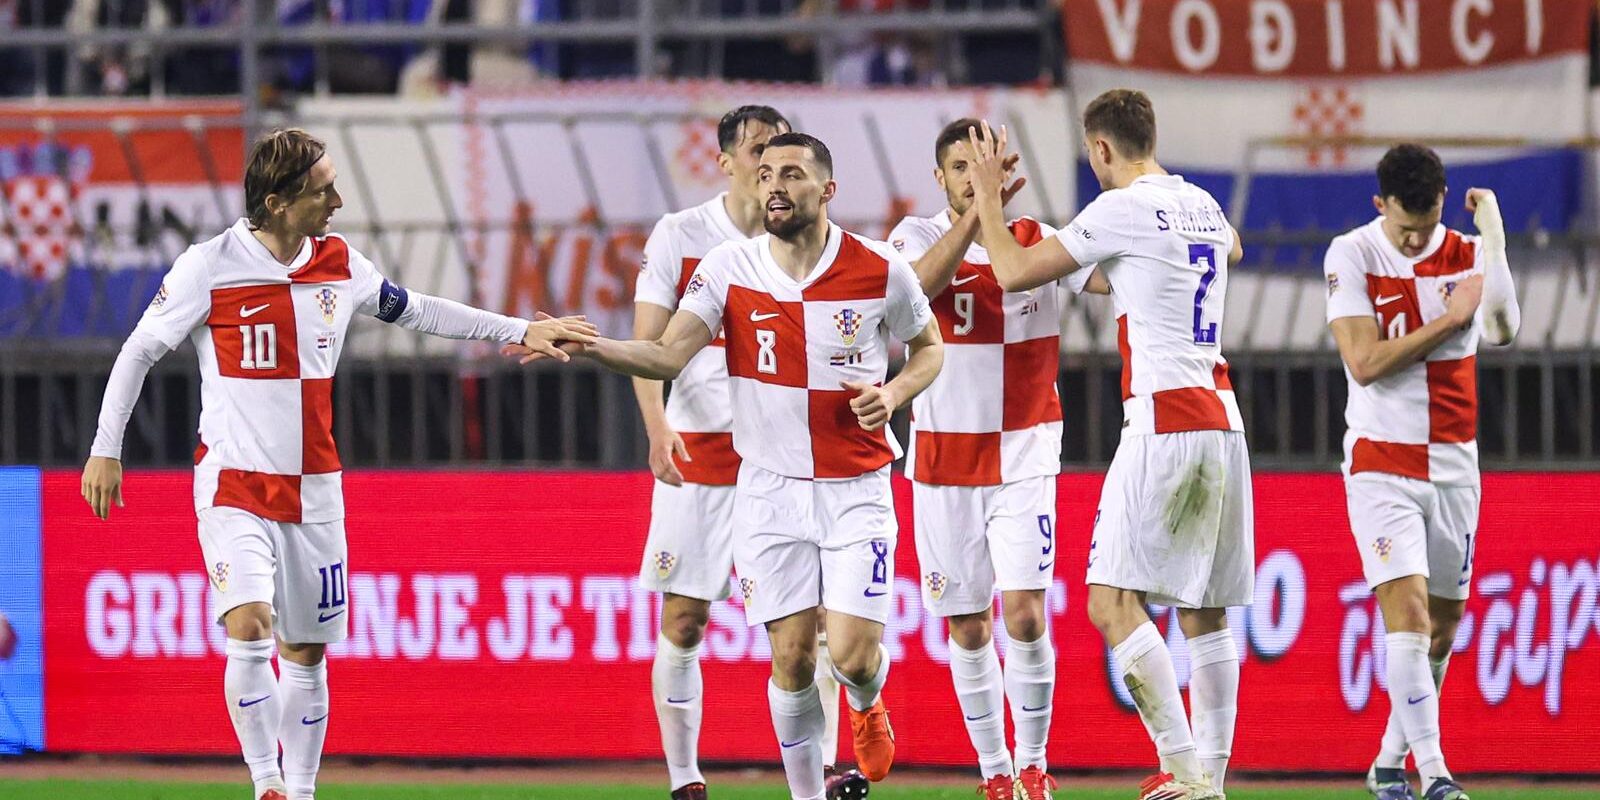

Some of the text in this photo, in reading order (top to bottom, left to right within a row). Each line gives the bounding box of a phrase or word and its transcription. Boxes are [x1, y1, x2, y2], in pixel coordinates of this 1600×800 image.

[953, 292, 975, 336] 9
[1188, 243, 1217, 346] 2
[239, 322, 278, 371] 10
[755, 328, 778, 376] 8
[1037, 514, 1052, 554] 9
[317, 562, 346, 609] 10
[871, 540, 888, 584] 8
[486, 572, 574, 661] JE
